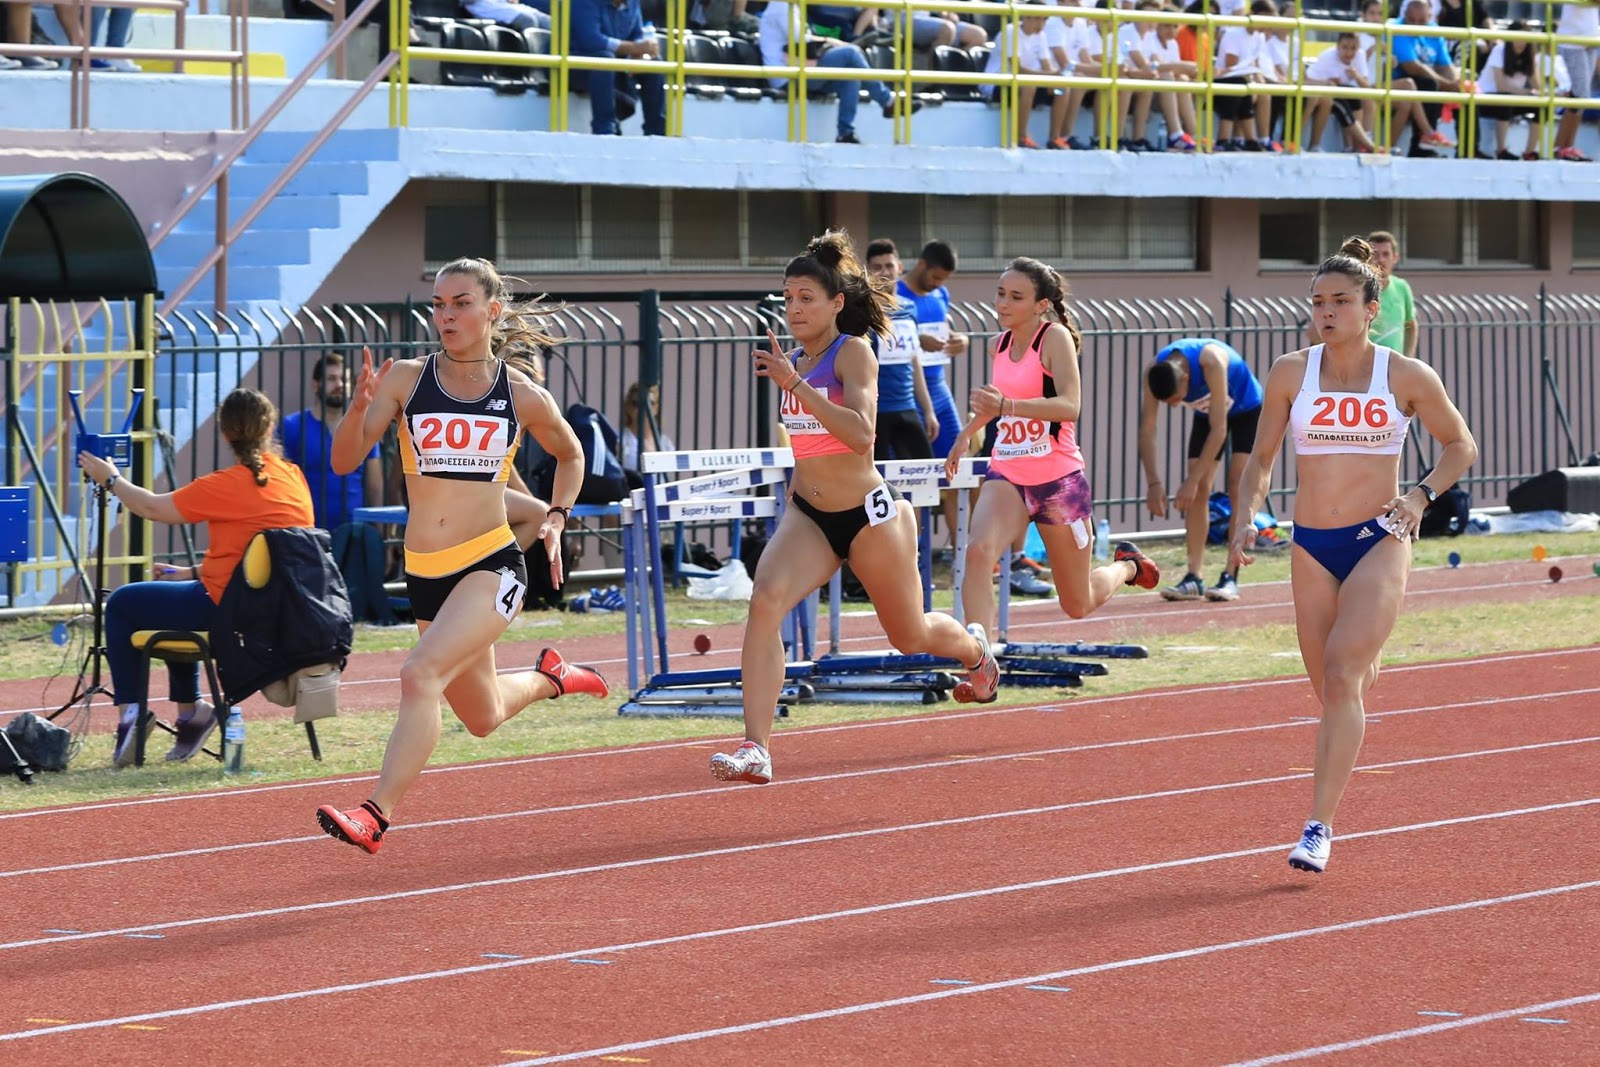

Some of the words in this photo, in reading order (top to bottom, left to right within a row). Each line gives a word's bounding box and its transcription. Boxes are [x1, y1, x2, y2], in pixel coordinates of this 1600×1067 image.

[1310, 396, 1388, 428] 206
[420, 417, 500, 451] 207
[1000, 419, 1044, 444] 209
[1307, 433, 1369, 442] ΠΑΠΑΦΛΕΣΣΕΙΑ
[1370, 432, 1392, 443] 2017
[1030, 445, 1047, 454] 2017
[478, 459, 500, 467] 2017
[701, 455, 752, 466] KALAMATA
[898, 466, 926, 475] Super
[690, 483, 712, 494] Super
[718, 476, 739, 488] Sport
[681, 507, 704, 517] Super
[710, 505, 731, 515] Sport
[872, 489, 889, 519] 5
[501, 584, 519, 614] 4
